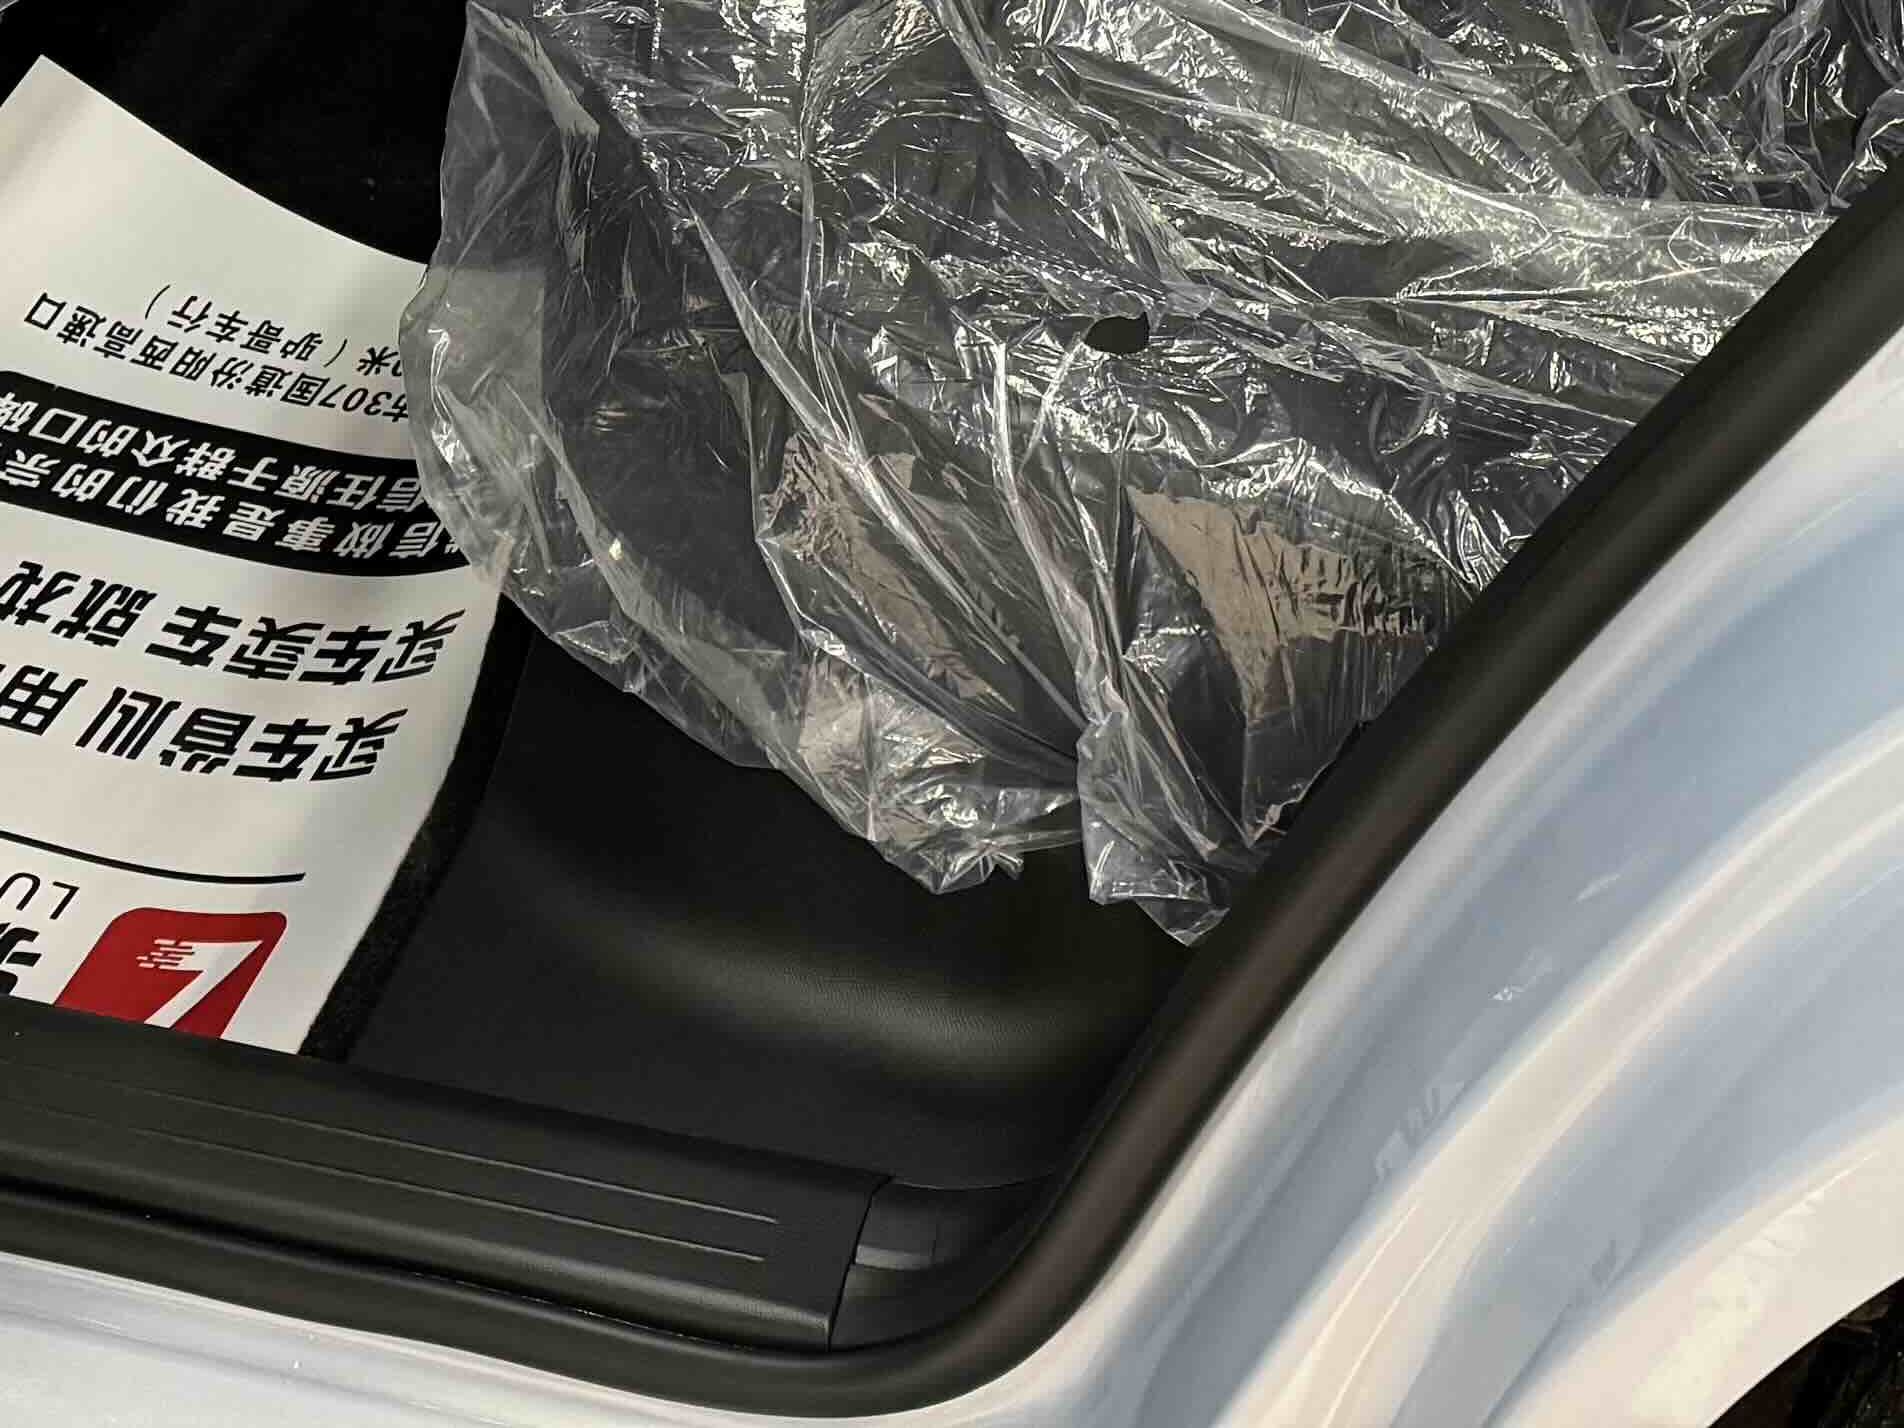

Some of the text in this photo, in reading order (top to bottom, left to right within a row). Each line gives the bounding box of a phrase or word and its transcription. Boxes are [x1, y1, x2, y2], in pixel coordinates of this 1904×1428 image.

[141, 602, 464, 686] 买车卖车
[76, 687, 406, 782] 买车省心
